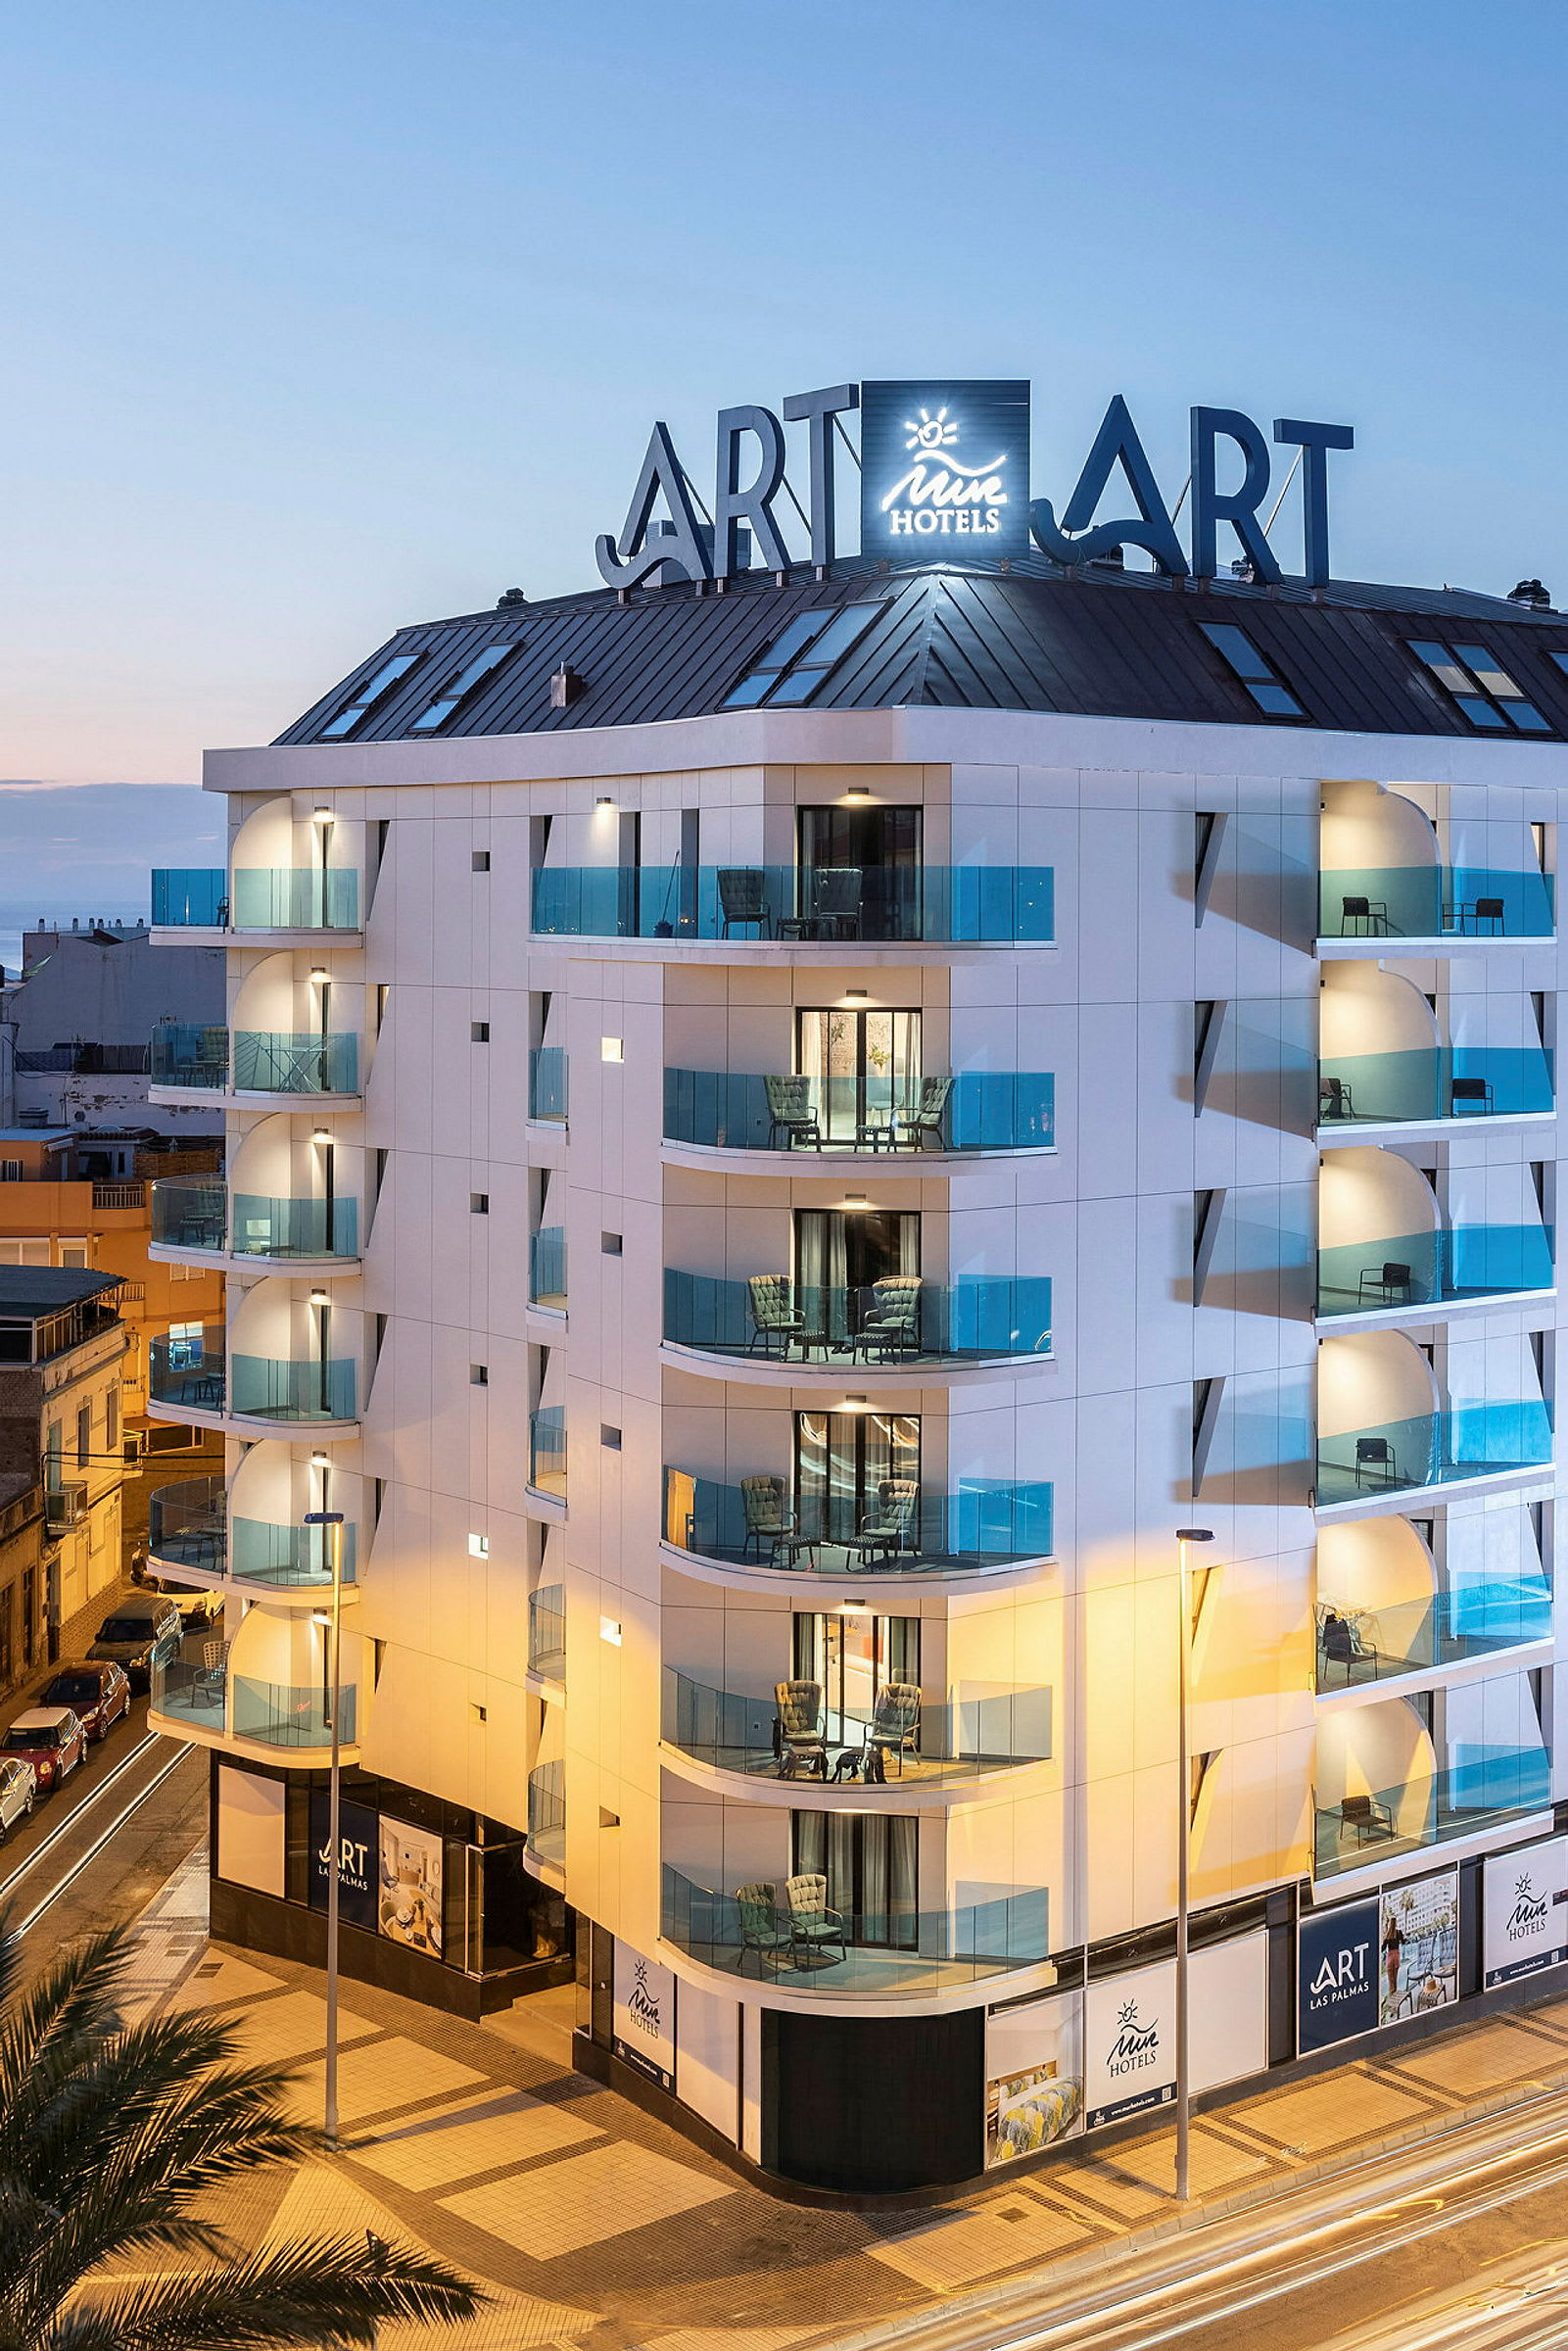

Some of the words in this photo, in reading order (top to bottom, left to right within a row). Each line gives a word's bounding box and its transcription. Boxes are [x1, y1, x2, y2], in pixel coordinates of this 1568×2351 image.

[595, 383, 860, 589] ART
[1029, 393, 1354, 588] ART
[889, 507, 1001, 535] HOTELS
[1509, 1918, 1546, 1942] HOTELS
[1309, 1942, 1369, 1994] ART
[1309, 1994, 1328, 2010] LAS
[1332, 1981, 1369, 2002] PALMAS
[630, 2009, 659, 2039] HOTELS
[1109, 2050, 1157, 2078] HOTELS
